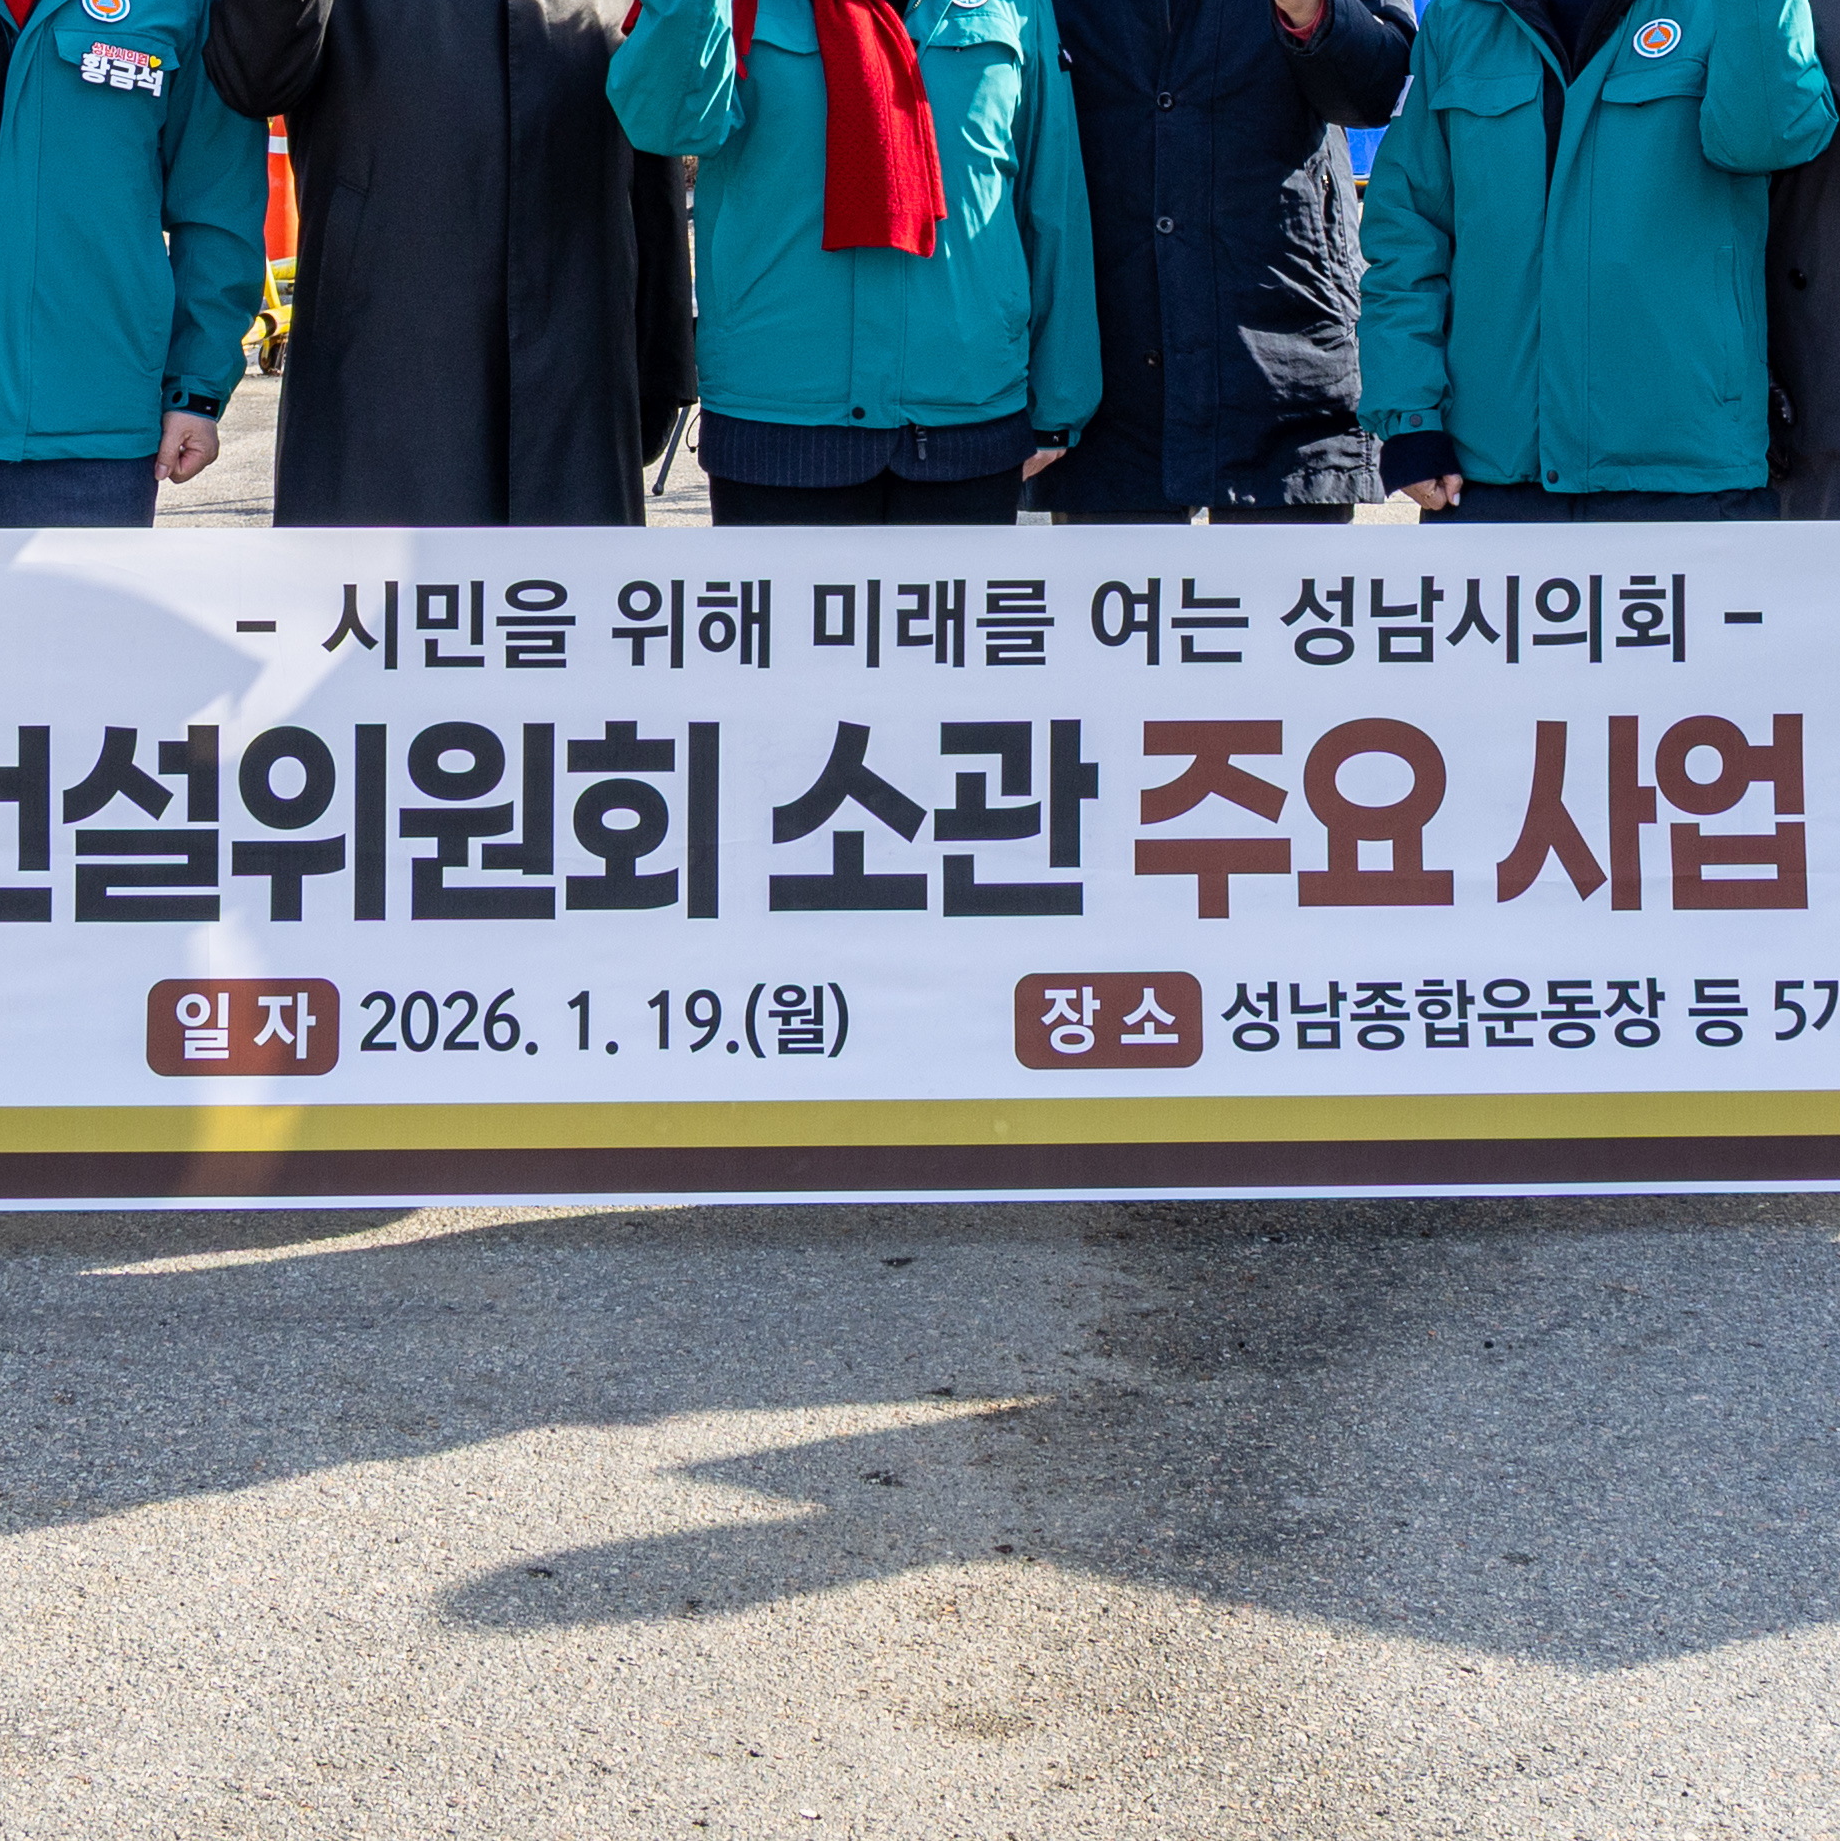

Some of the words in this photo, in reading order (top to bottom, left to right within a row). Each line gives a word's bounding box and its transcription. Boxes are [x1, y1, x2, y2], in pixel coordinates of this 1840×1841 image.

[80, 52, 165, 98] 황금석
[320, 578, 577, 672] 시민을
[610, 578, 773, 670] 위해
[812, 577, 1056, 670] 미래를
[1089, 576, 1250, 667] 여는
[1278, 572, 1687, 667] 성남시의회
[767, 717, 1100, 919] 소관
[1133, 716, 1456, 921] 주요
[1495, 712, 1810, 913] 사업
[358, 986, 540, 1057] 2026.
[566, 989, 620, 1056] 1.
[1220, 976, 1667, 1053] 성남종합운동장
[1687, 977, 1750, 1049] 등
